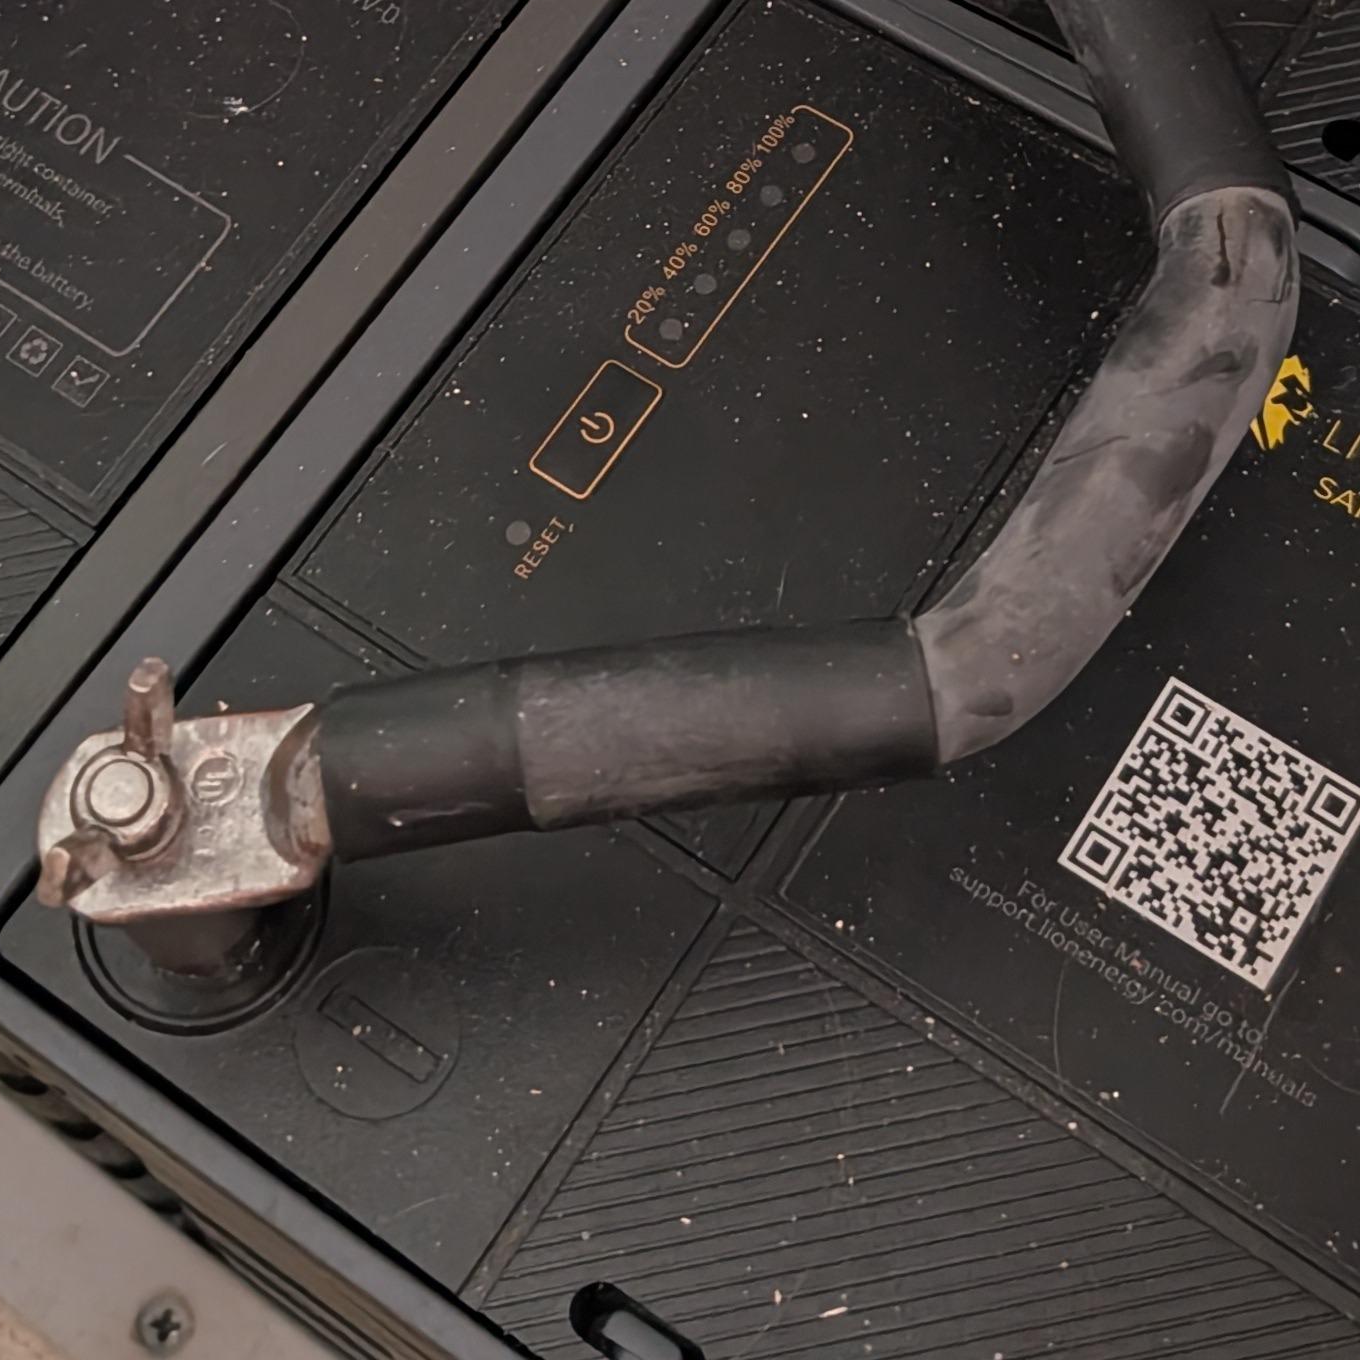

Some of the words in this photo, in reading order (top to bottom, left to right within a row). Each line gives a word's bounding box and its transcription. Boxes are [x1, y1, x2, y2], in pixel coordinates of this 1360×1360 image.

[626, 285, 668, 325] 20%
[661, 241, 700, 281] 40%
[692, 198, 732, 238] 60%
[725, 157, 764, 195] 80%
[755, 113, 796, 155] 100%
[513, 515, 567, 581] RESET
[1015, 878, 1059, 917] For
[1057, 904, 1112, 952] User
[1112, 940, 1204, 1006] Manual
[1200, 999, 1235, 1028] go
[1235, 1017, 1265, 1046] to
